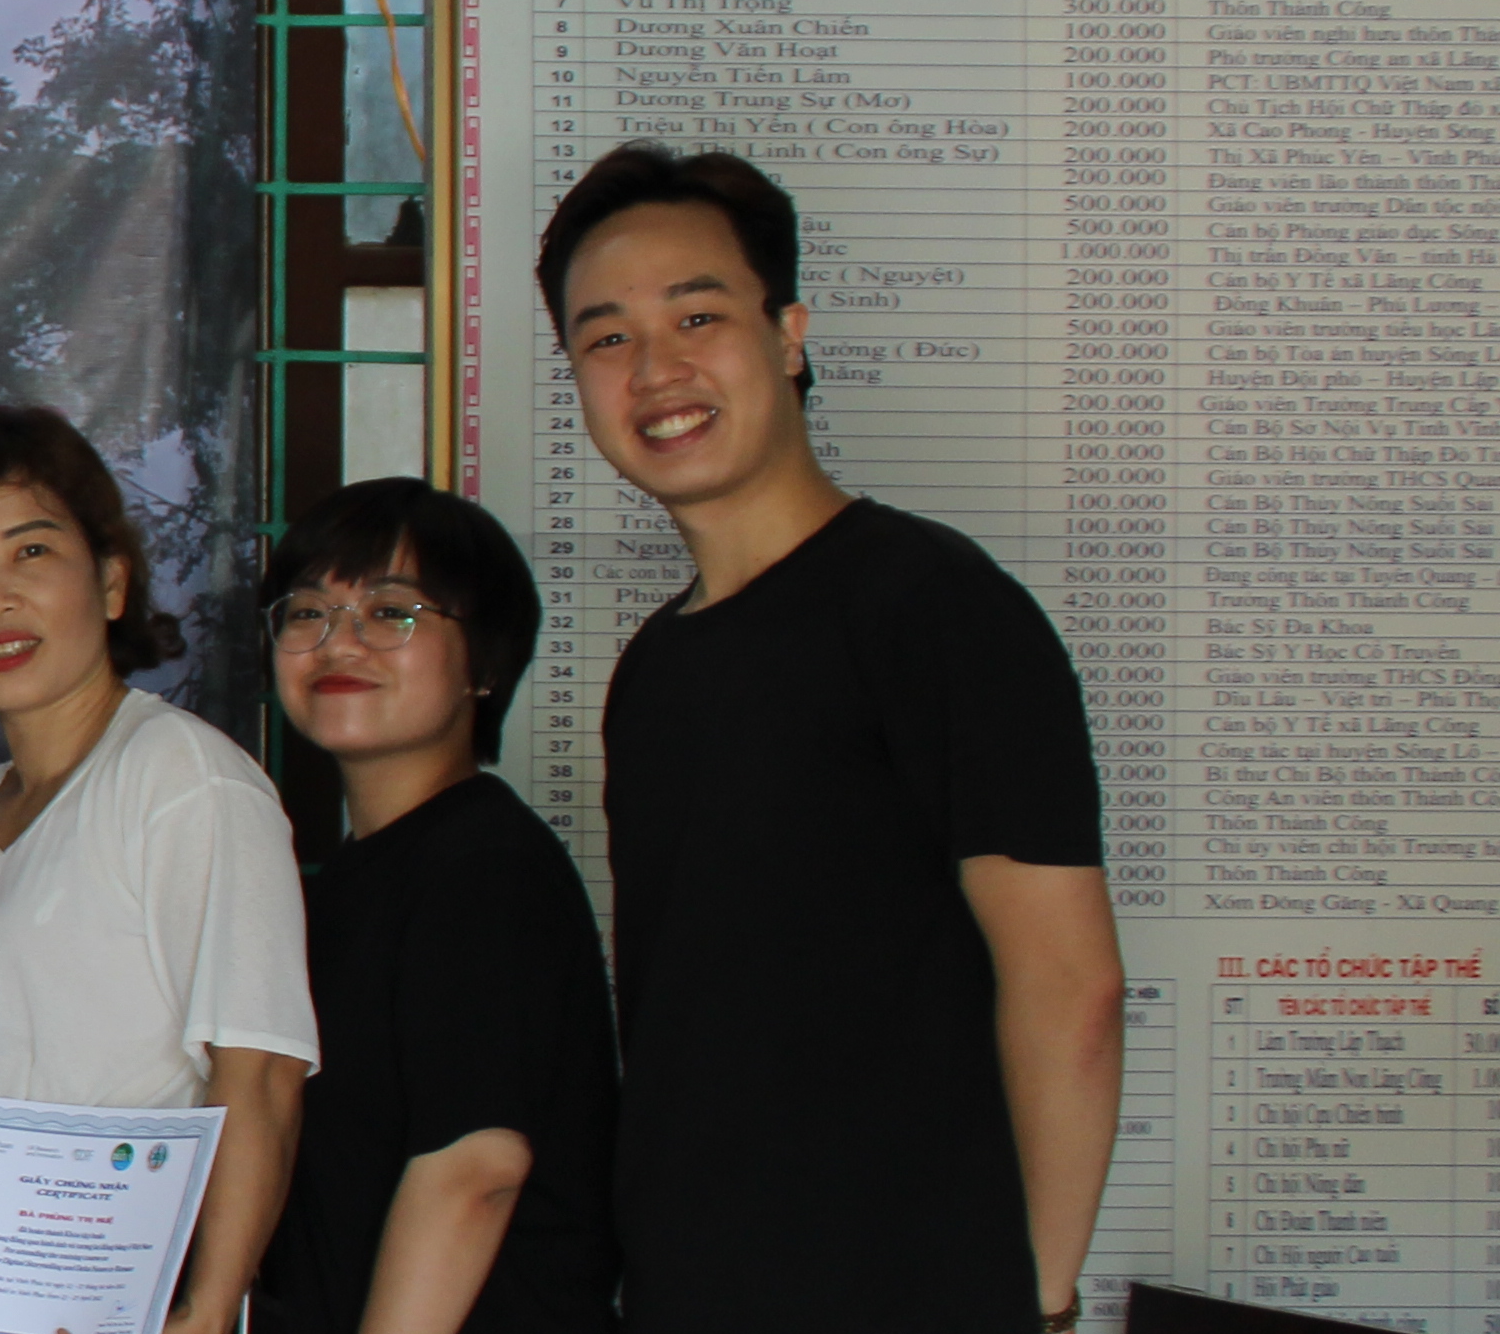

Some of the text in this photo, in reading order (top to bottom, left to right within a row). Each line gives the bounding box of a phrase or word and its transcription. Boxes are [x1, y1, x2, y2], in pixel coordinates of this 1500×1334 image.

[1318, 618, 1375, 635] Khoa
[1256, 953, 1299, 979] CÁC
[1304, 945, 1332, 979] TỔ
[1336, 953, 1393, 979] CHỨC
[1399, 952, 1439, 984] TẬP
[1443, 947, 1484, 979] THỂ
